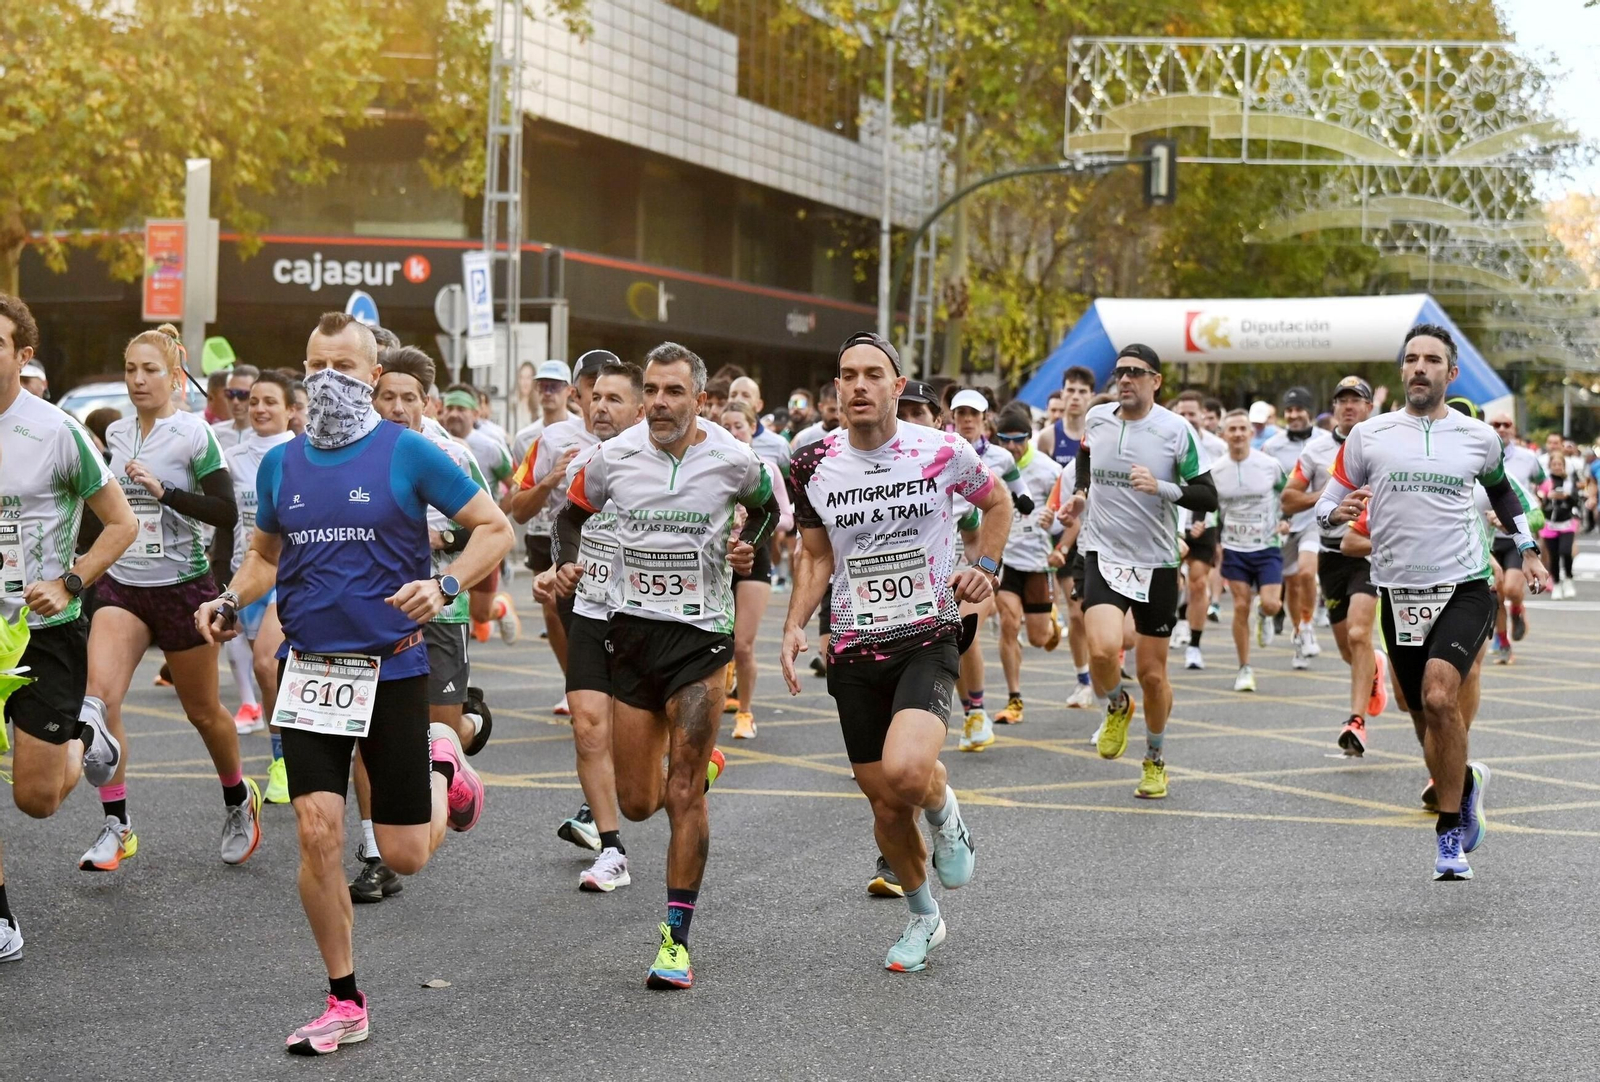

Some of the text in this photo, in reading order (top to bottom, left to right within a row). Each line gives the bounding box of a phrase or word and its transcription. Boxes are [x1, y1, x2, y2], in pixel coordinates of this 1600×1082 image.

[273, 252, 402, 292] cajasur
[1241, 319, 1330, 335] Diputación
[1239, 335, 1330, 350] de Córdoba
[13, 425, 30, 437] SIG
[1455, 425, 1469, 436] SIG
[709, 449, 724, 460] SIG
[1388, 472, 1464, 487] XII SUBIDA
[826, 477, 938, 508] ANTIGRUPETA
[1421, 486, 1461, 496] ERMITAS
[629, 509, 710, 524] XII SUBIDA
[835, 502, 934, 529] RUN & TRAIL
[288, 527, 376, 546] TROTASIERRA
[641, 524, 661, 532] LAS
[663, 525, 707, 535] ERMITAS
[639, 572, 684, 596] 553
[868, 575, 914, 603] 590
[300, 680, 354, 709] 610
